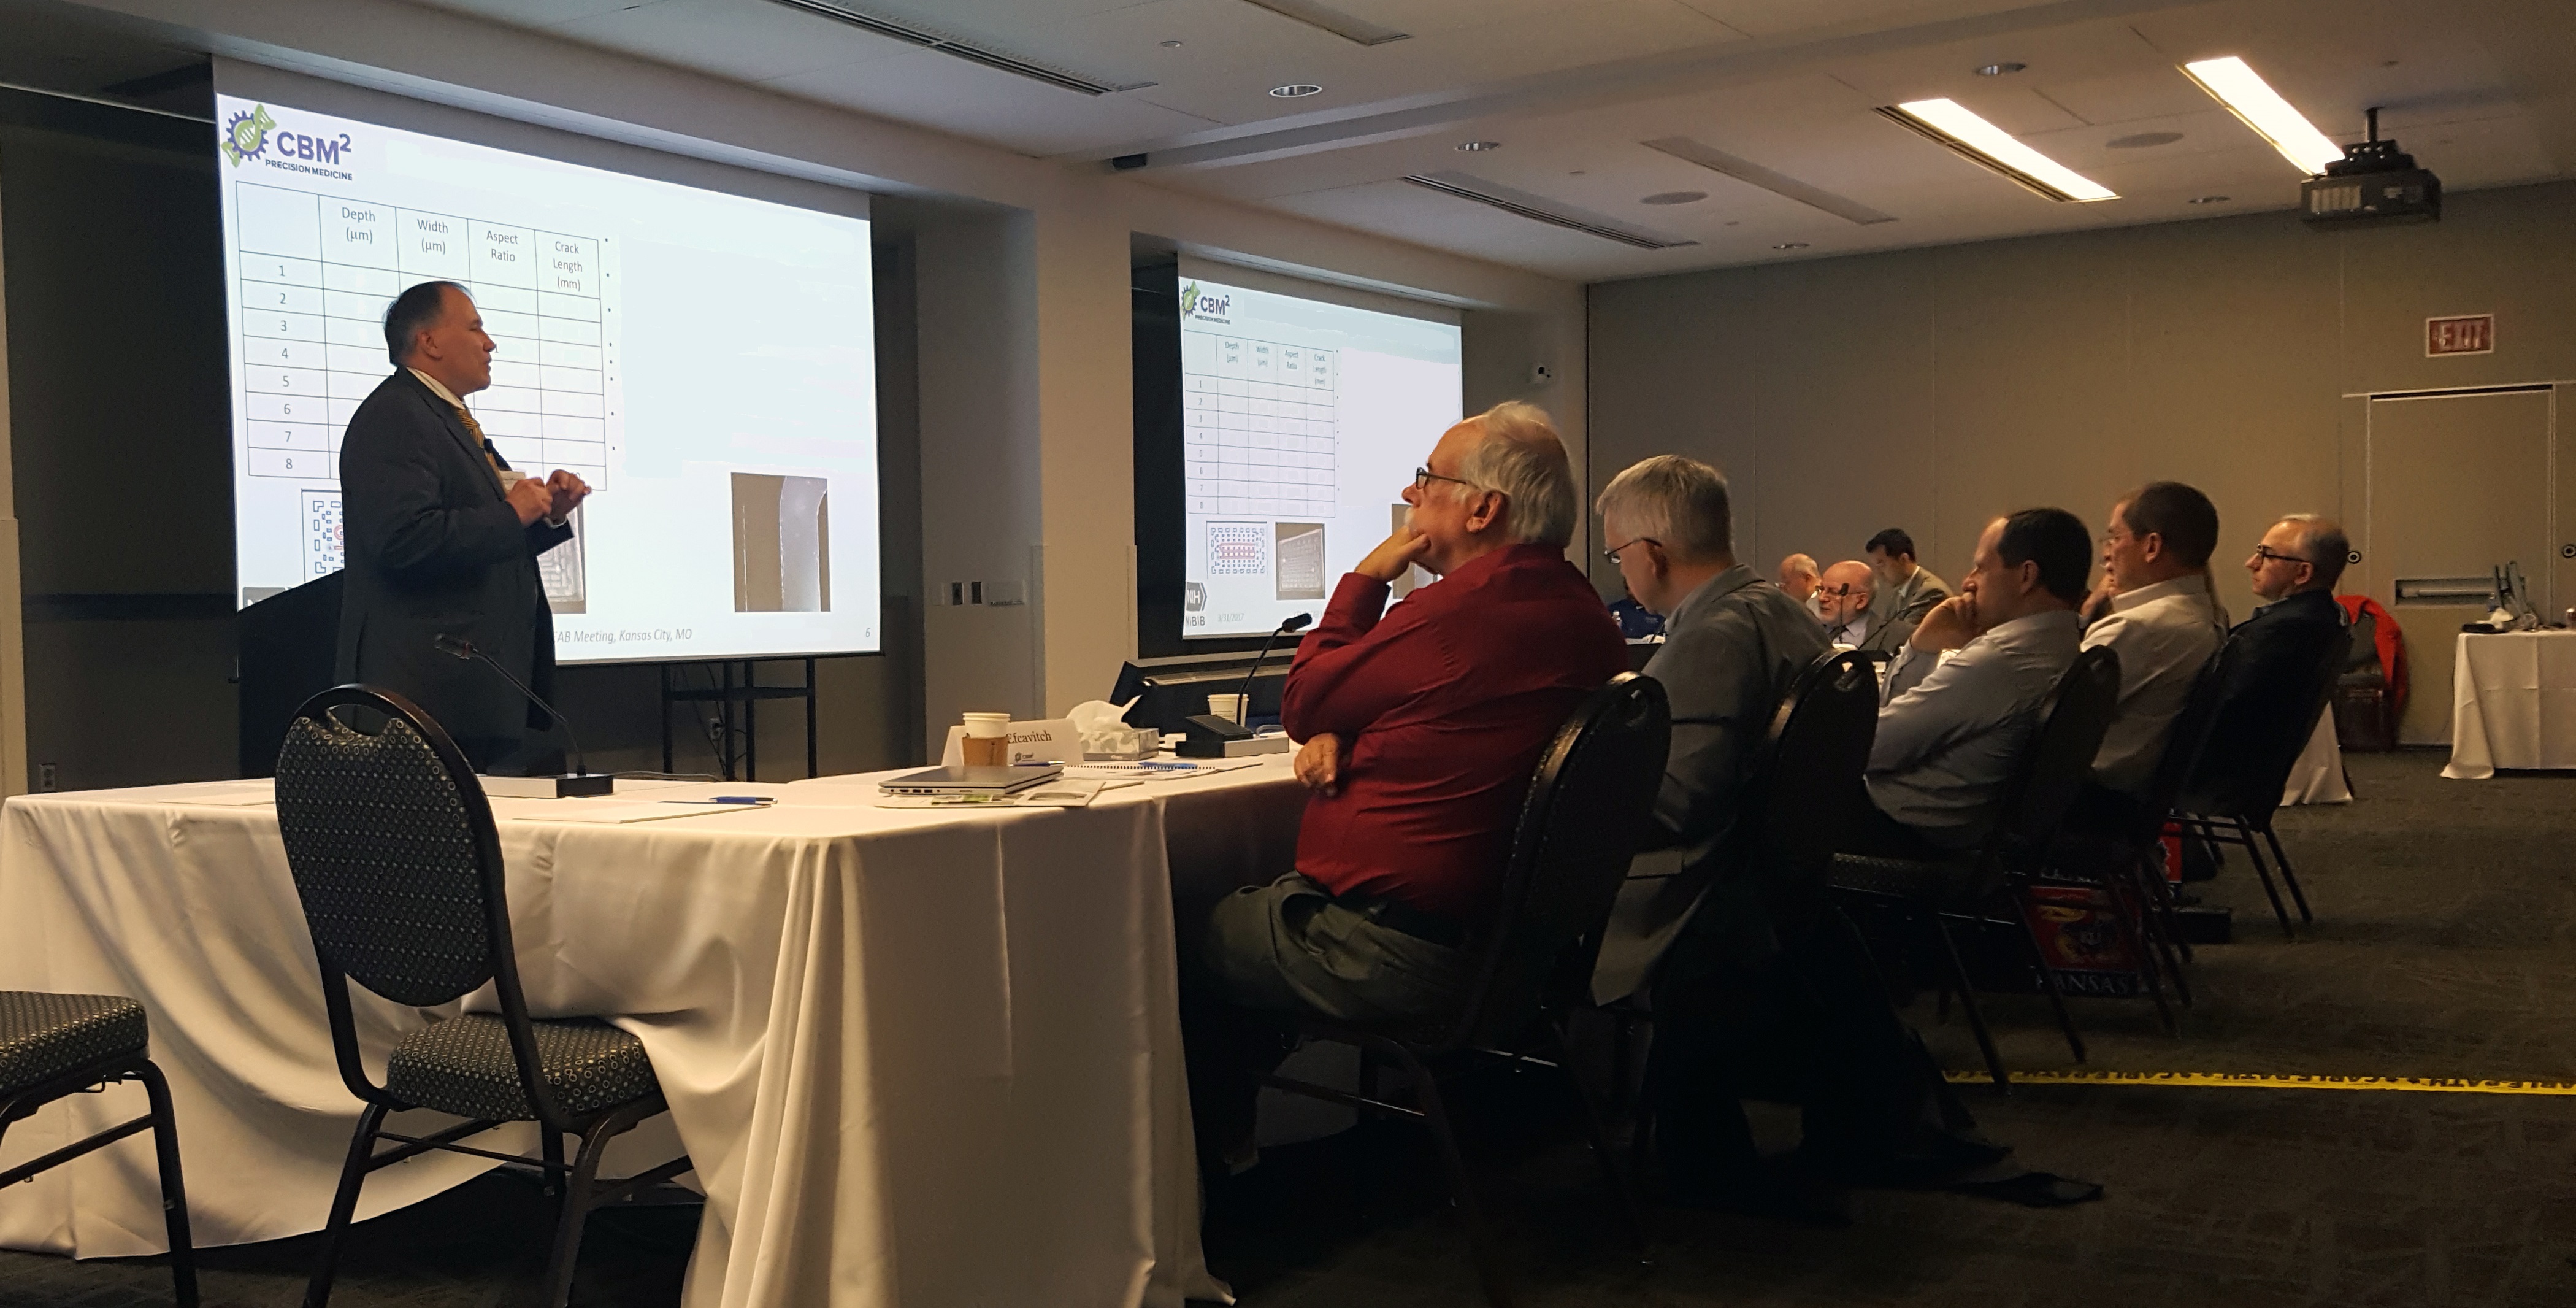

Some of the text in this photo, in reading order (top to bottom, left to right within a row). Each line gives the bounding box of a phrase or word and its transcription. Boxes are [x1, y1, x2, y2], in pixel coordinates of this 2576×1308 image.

[265, 158, 353, 181] PRECISION MEDICINE
[342, 207, 376, 223] Depth
[417, 218, 449, 234] Width
[486, 230, 519, 245] Aspect
[554, 241, 580, 255] Crack
[491, 248, 516, 263] Ratio
[278, 265, 285, 277] 1
[553, 258, 583, 274] Length
[556, 276, 581, 292] (mm)
[279, 293, 286, 304] 2
[280, 320, 287, 332] 3
[282, 348, 289, 359] 4
[282, 375, 289, 387] 5
[283, 403, 291, 415] 6
[284, 430, 291, 442] 7
[285, 458, 293, 470] 8
[1187, 589, 1200, 604] NIH
[574, 630, 616, 644] Meeting,
[619, 629, 651, 642] Kansas
[654, 629, 673, 642] City,
[676, 628, 692, 640] MO
[865, 627, 871, 638] 6
[1006, 729, 1052, 744] Efcavitch
